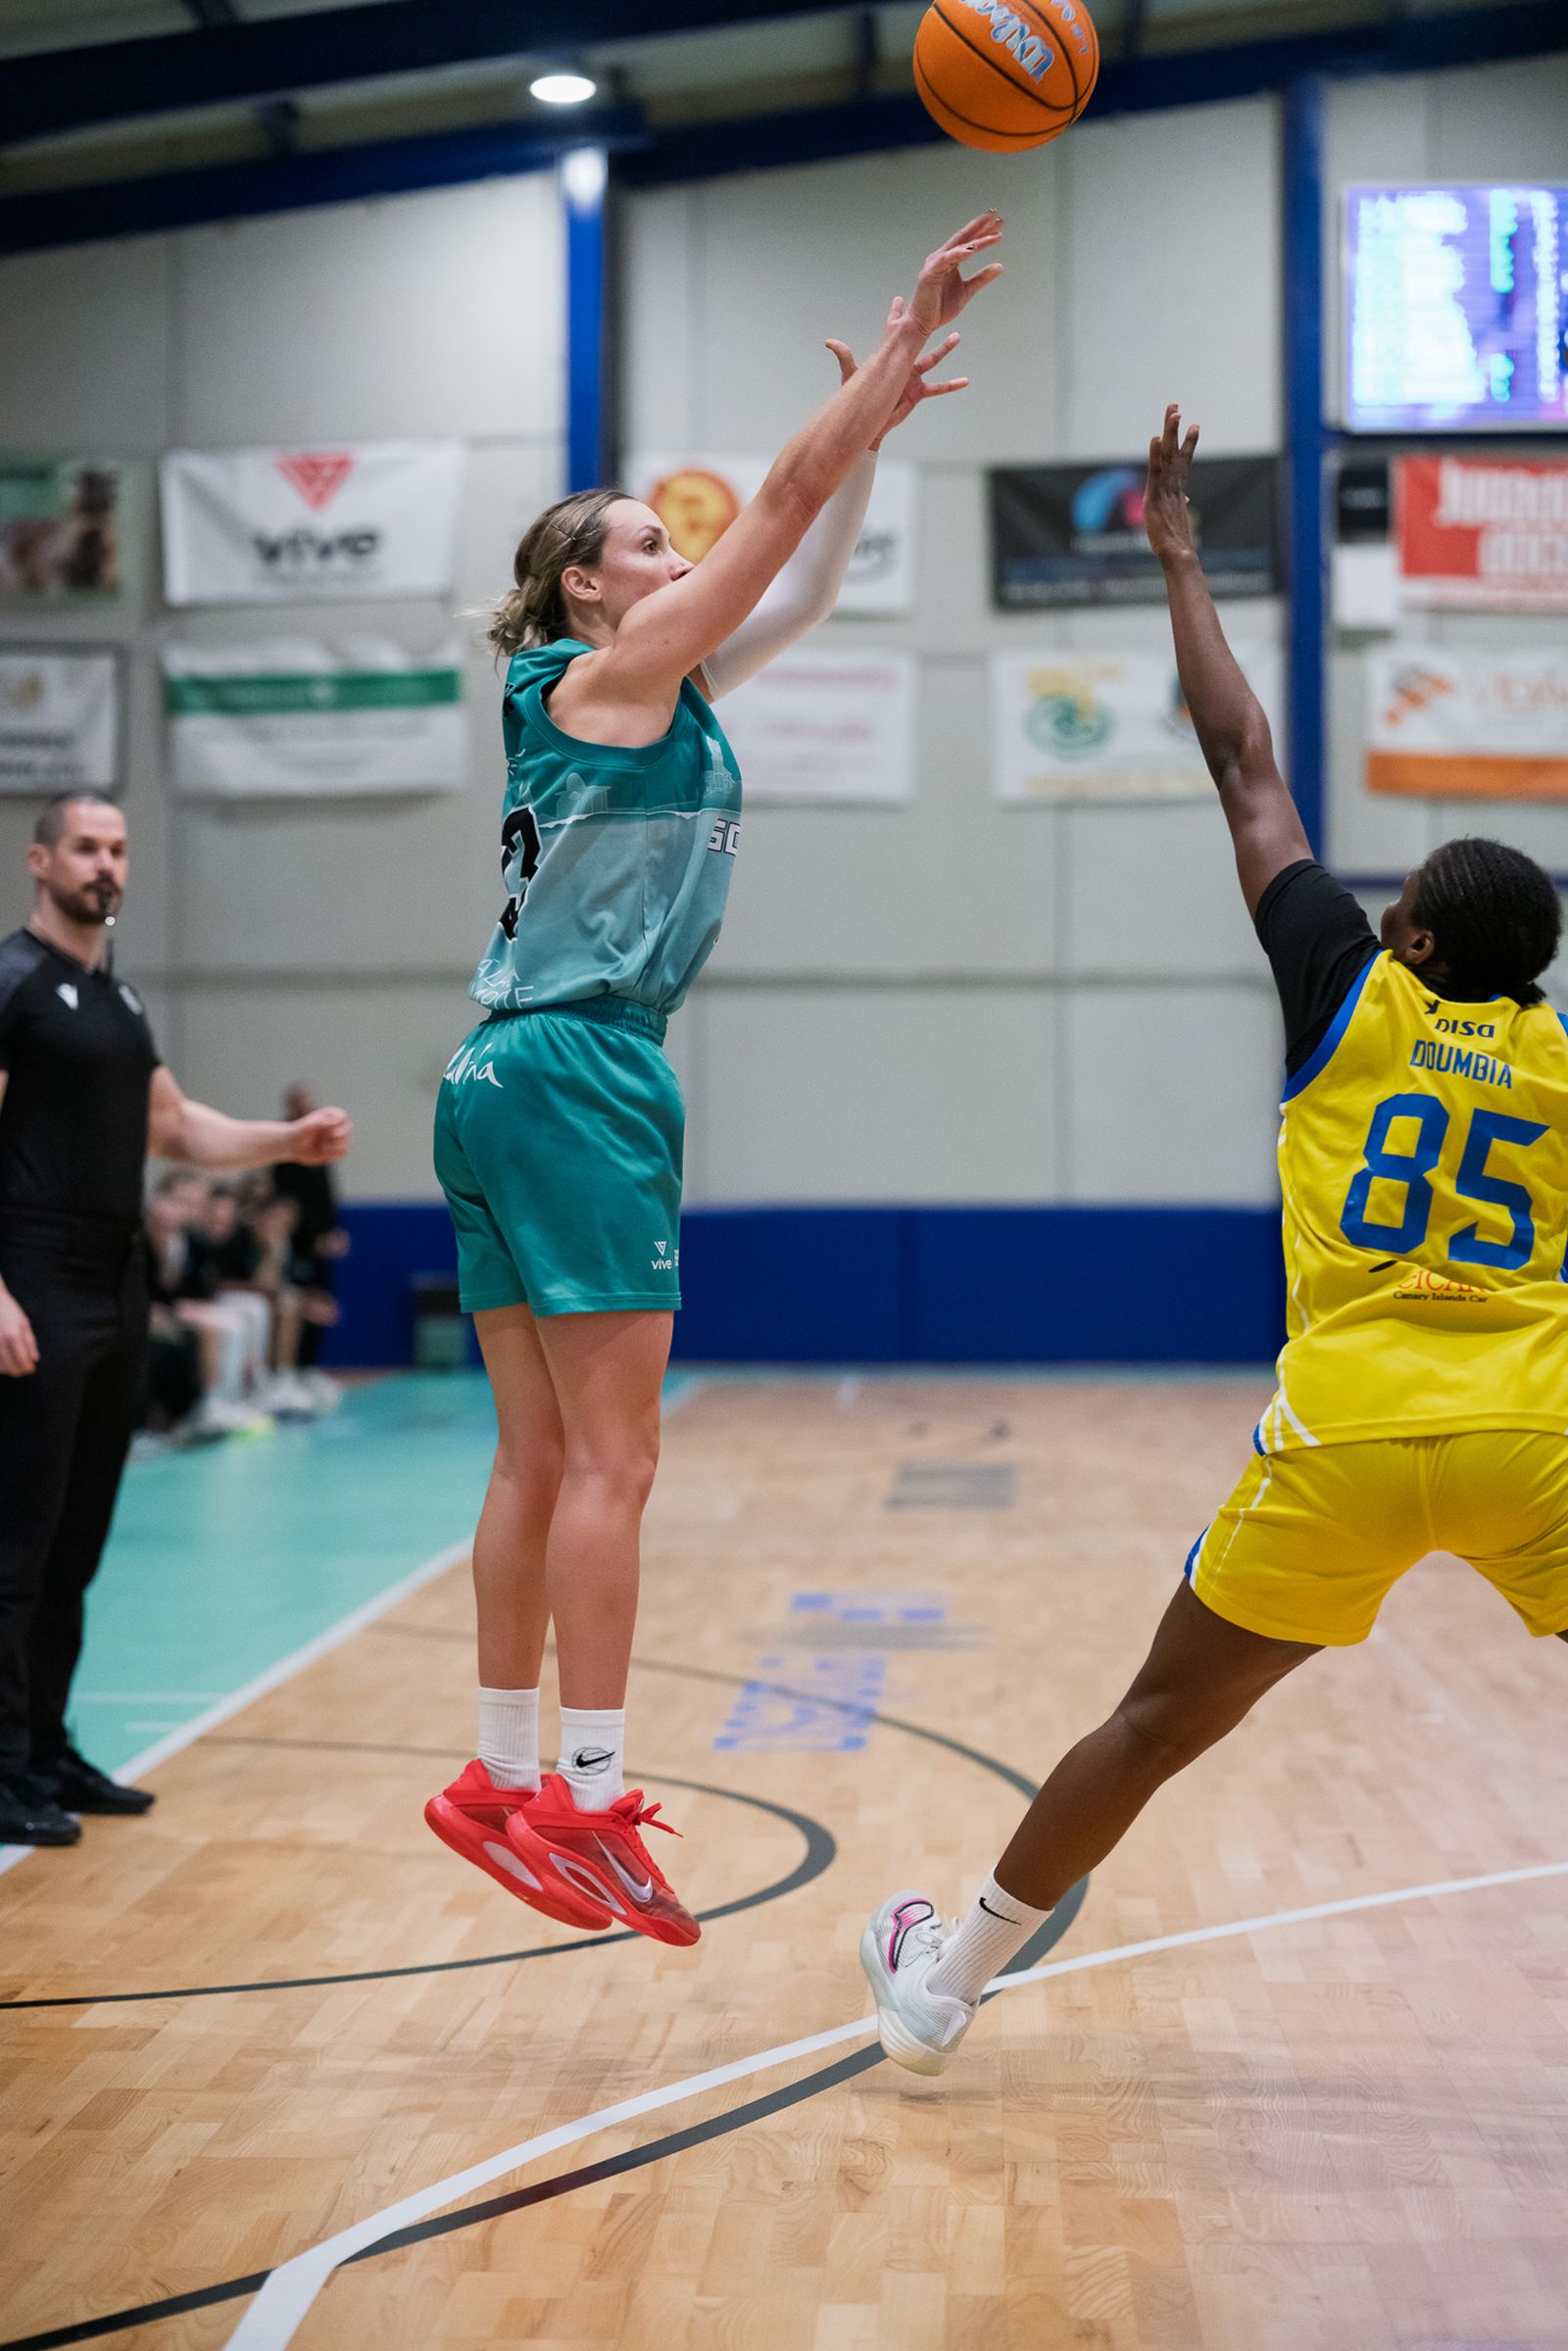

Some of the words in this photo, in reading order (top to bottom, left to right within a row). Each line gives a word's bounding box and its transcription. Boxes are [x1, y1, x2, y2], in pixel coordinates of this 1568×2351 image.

[1409, 1039, 1513, 1090] DOUMBIA
[1339, 1093, 1551, 1271] 85
[651, 1258, 672, 1270] vive
[1398, 1269, 1488, 1293] CIC
